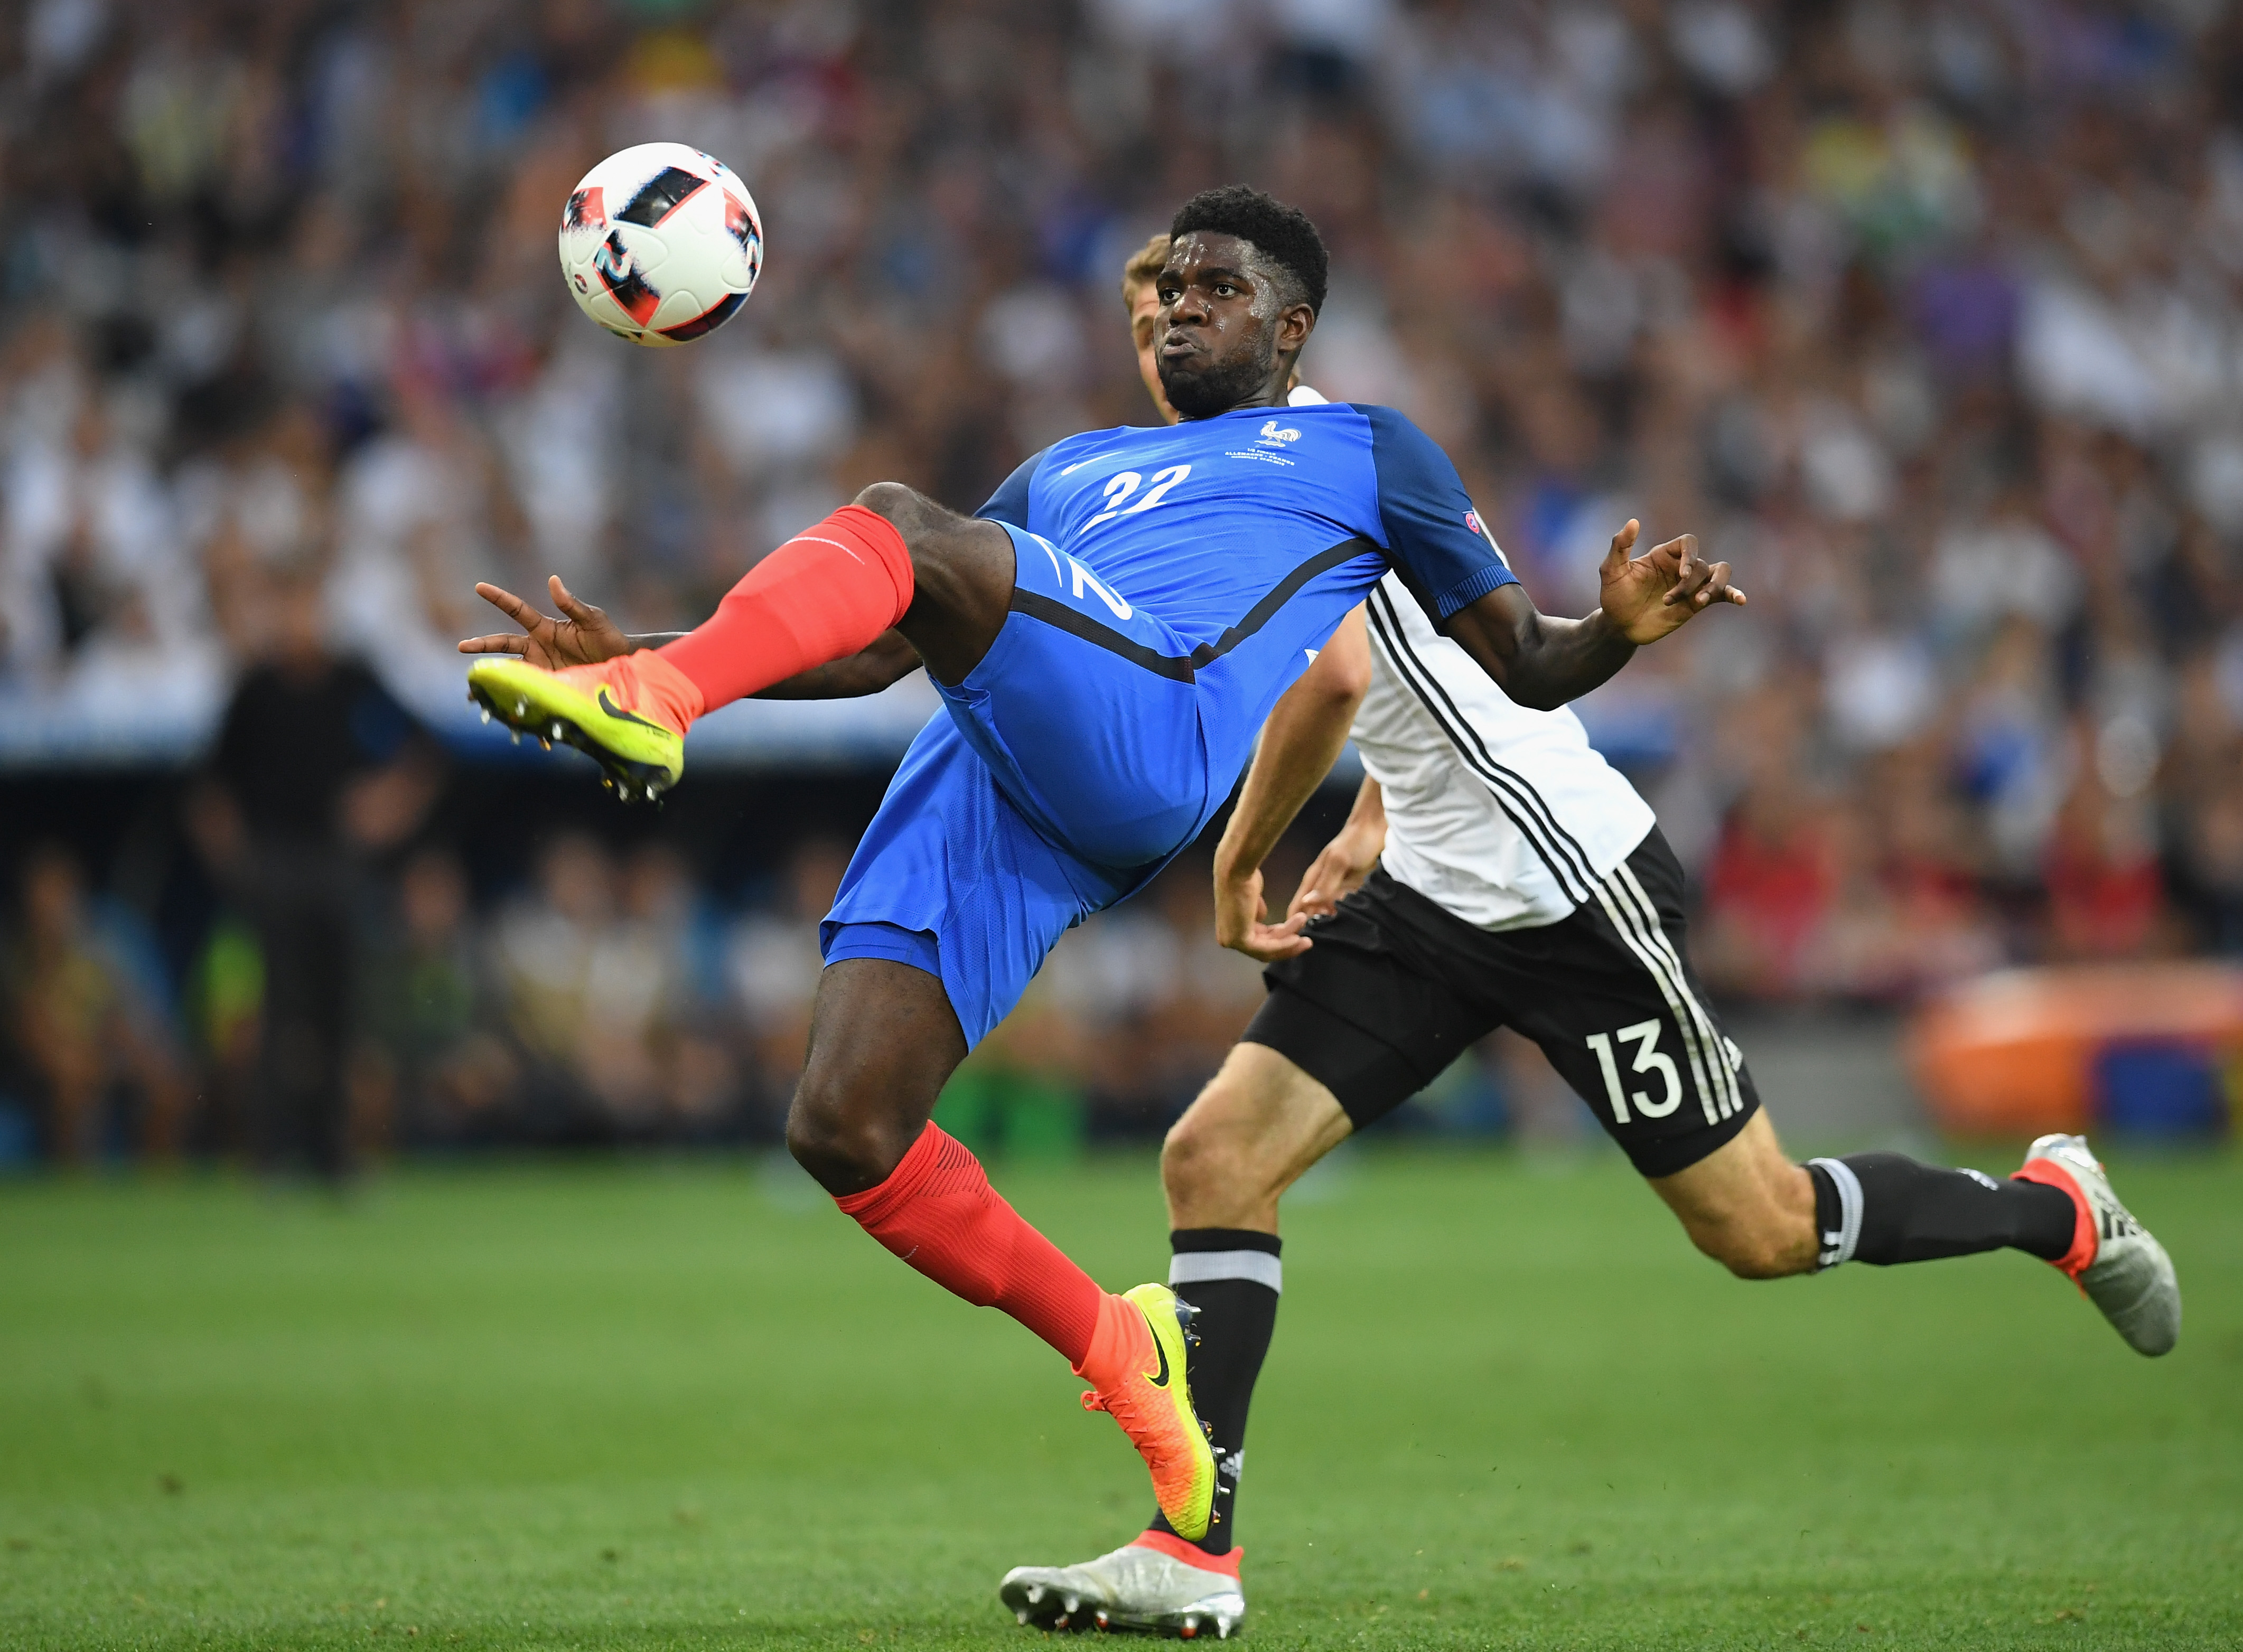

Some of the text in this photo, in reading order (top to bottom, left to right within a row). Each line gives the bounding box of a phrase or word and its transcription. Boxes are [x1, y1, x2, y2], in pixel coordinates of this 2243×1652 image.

[1269, 455, 1295, 466] FRANCE
[1080, 465, 1192, 535] 22
[1586, 1018, 1683, 1124] 13
